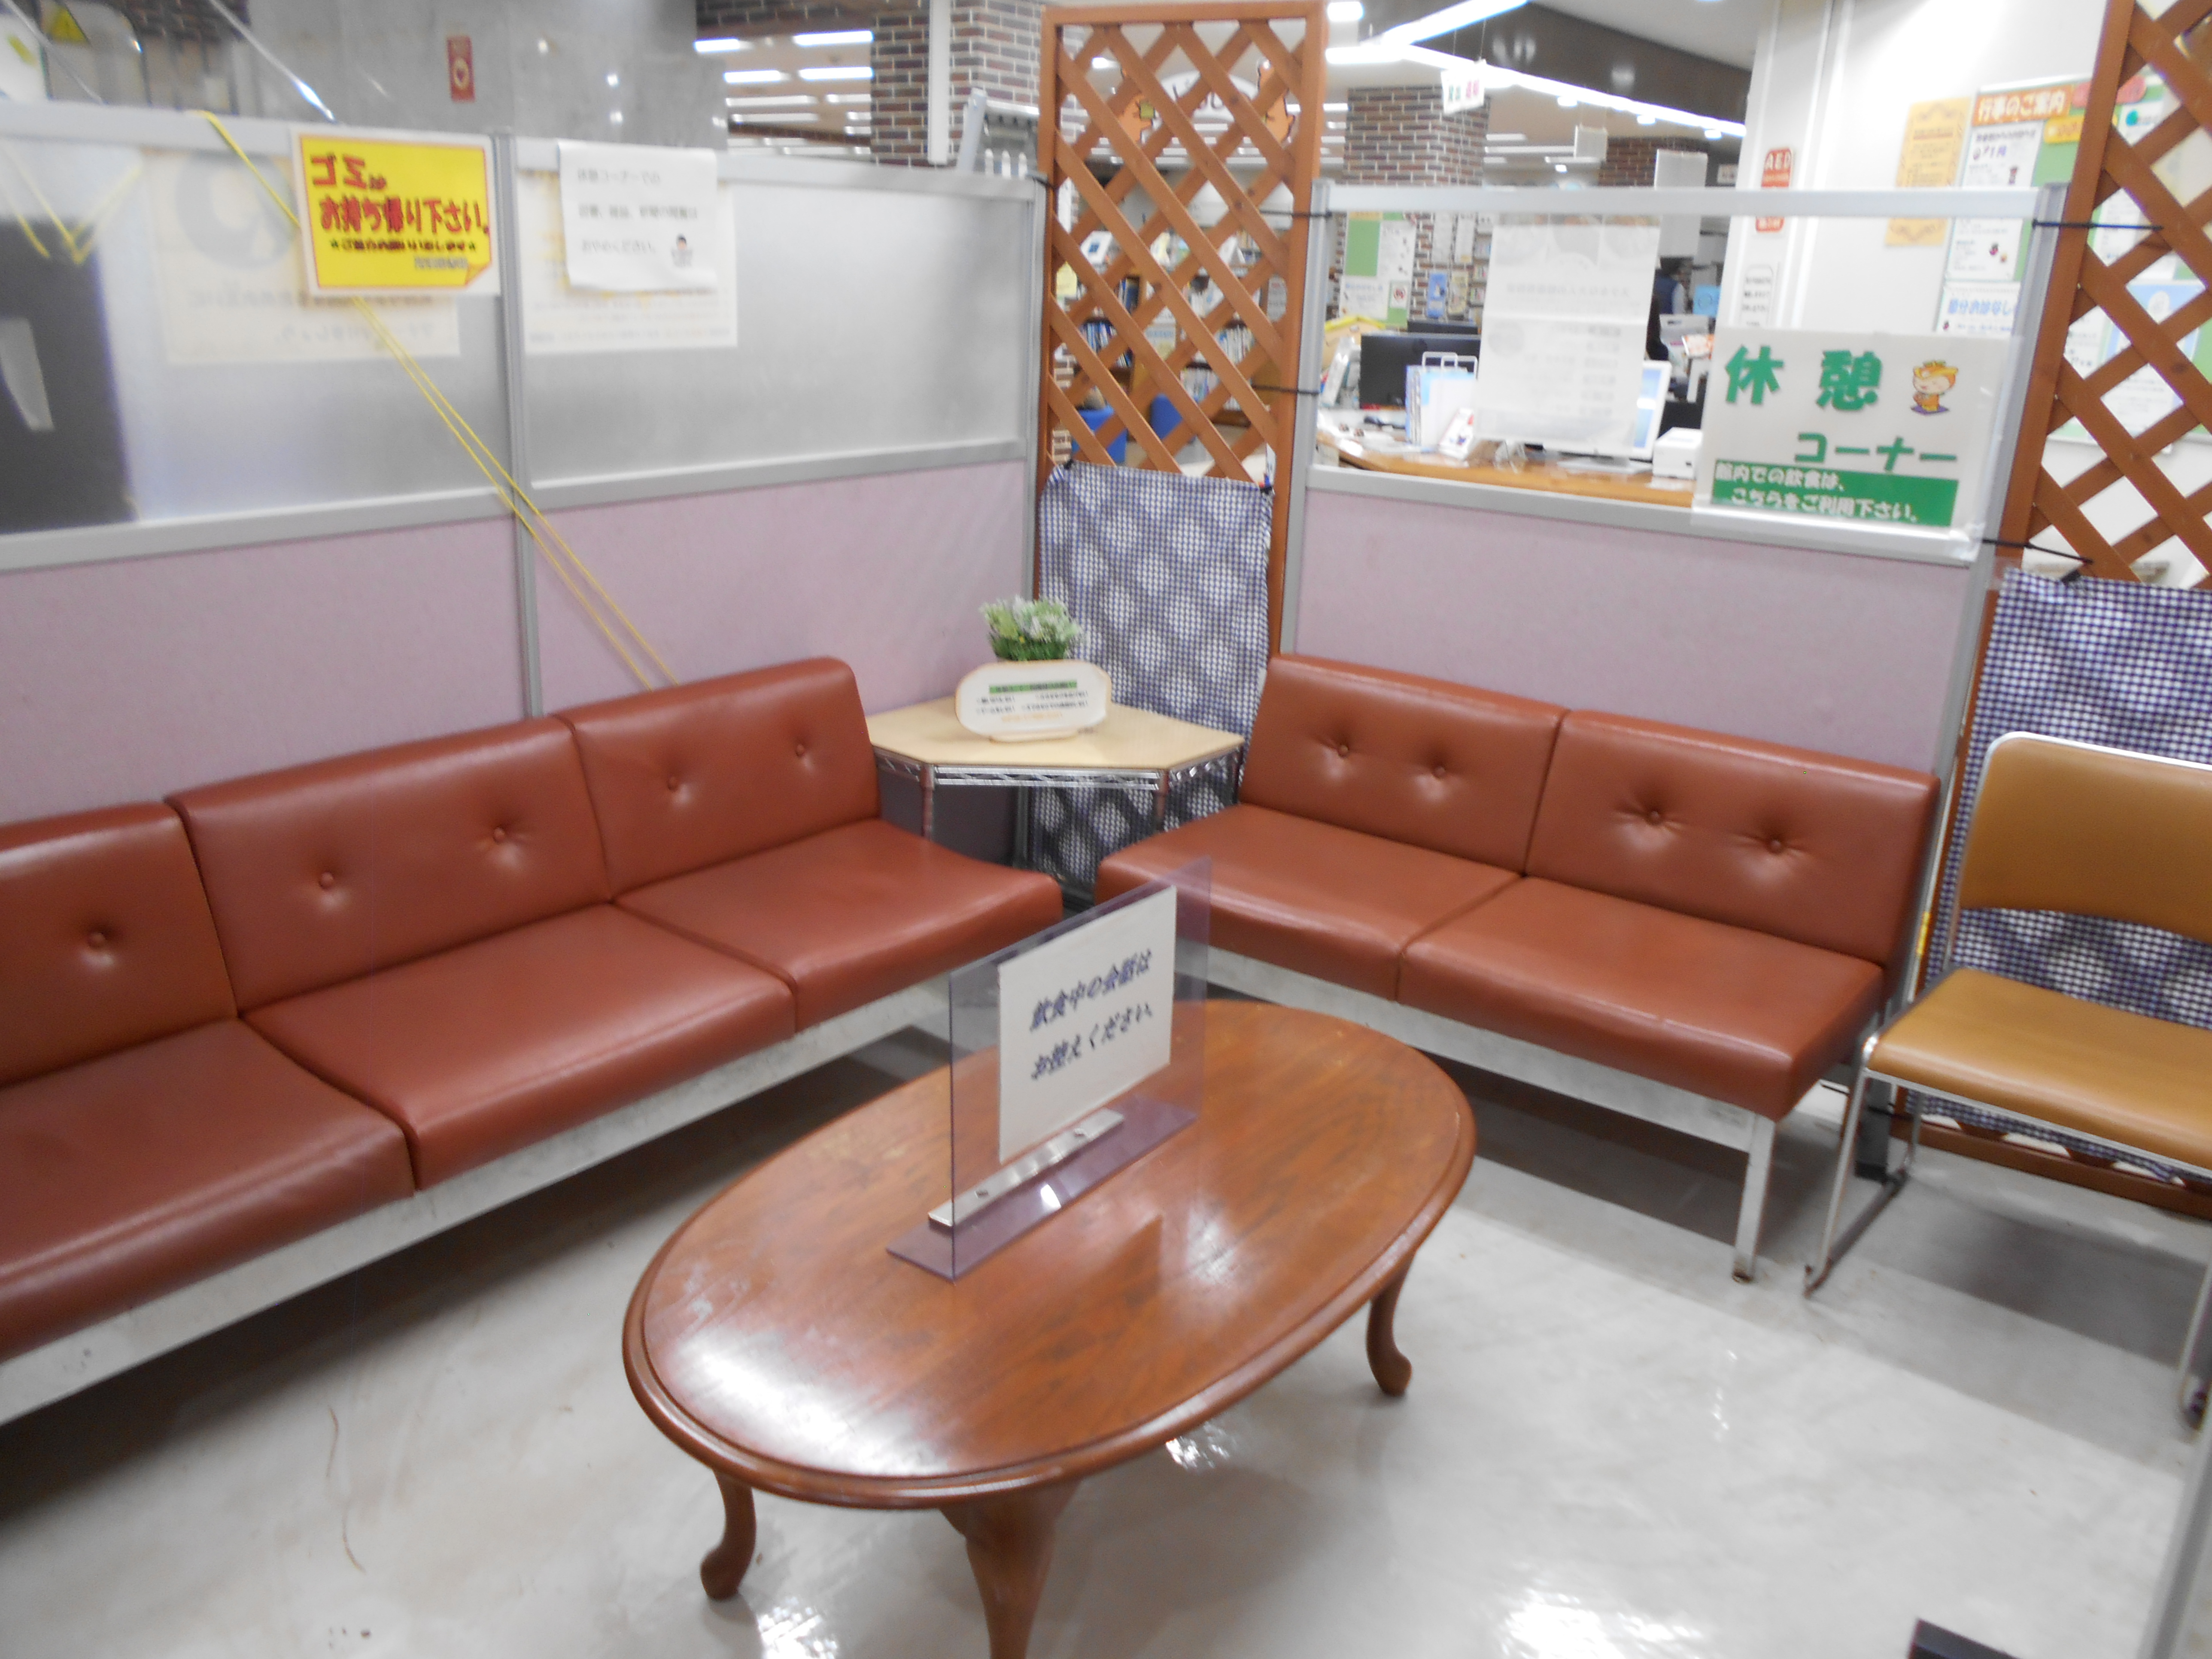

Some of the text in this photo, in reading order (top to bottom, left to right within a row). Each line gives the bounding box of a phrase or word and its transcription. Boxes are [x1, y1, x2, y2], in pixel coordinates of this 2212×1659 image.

[311, 153, 386, 190] ゴミは
[321, 196, 489, 234] お持ち帰り下さい。
[1794, 431, 1957, 472] コーナー
[1731, 488, 1917, 523] こちらをご利用下さい。
[1030, 948, 1152, 1032] 飲食中の会話は
[1031, 1003, 1153, 1080] お控えください
